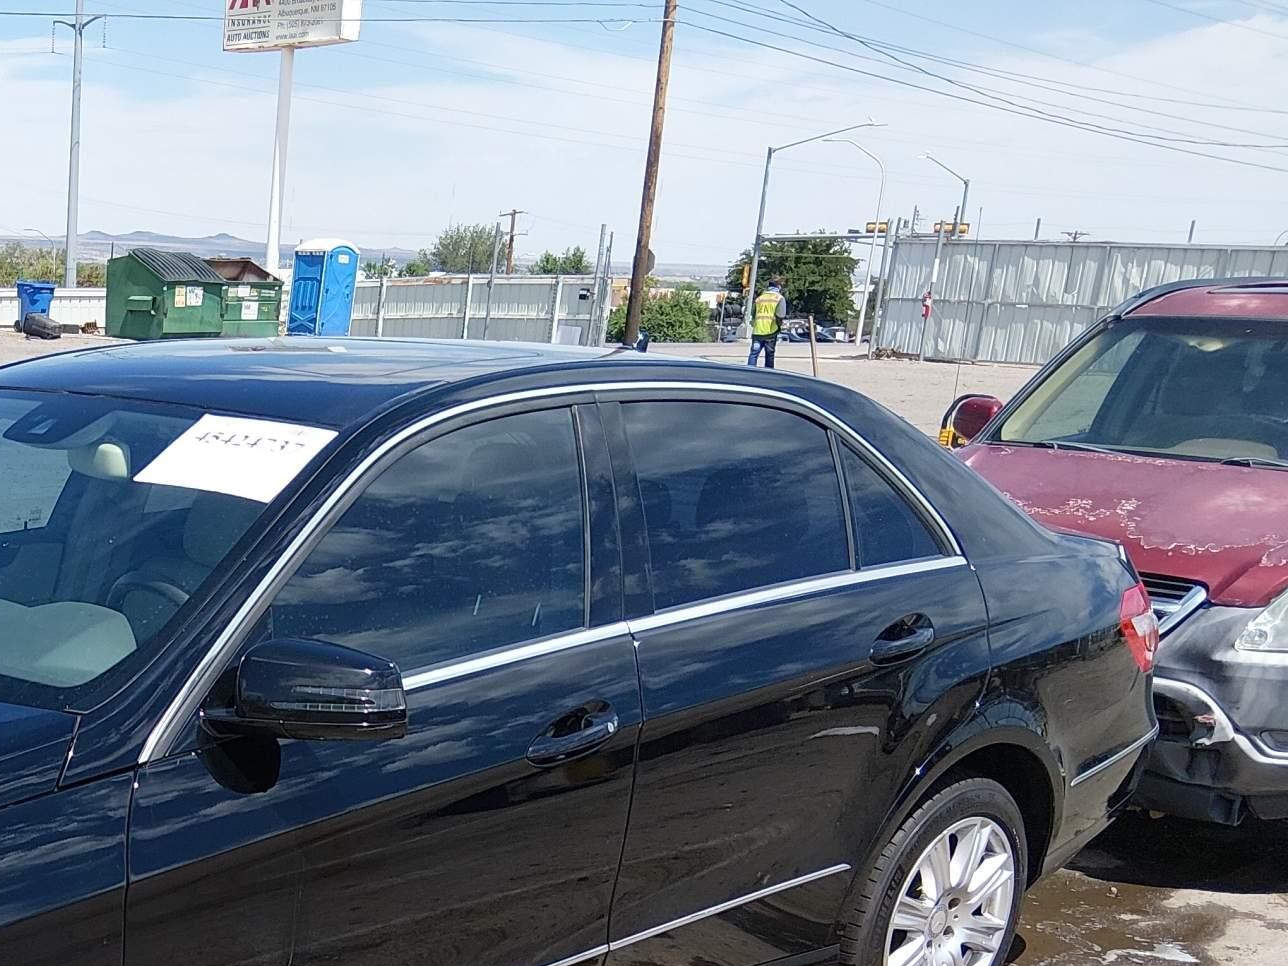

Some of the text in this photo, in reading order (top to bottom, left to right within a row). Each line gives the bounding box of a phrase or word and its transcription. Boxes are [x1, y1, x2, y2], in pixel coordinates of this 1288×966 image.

[227, 14, 271, 28] INSURANCE
[227, 30, 270, 42] AUTO AUCTIONS
